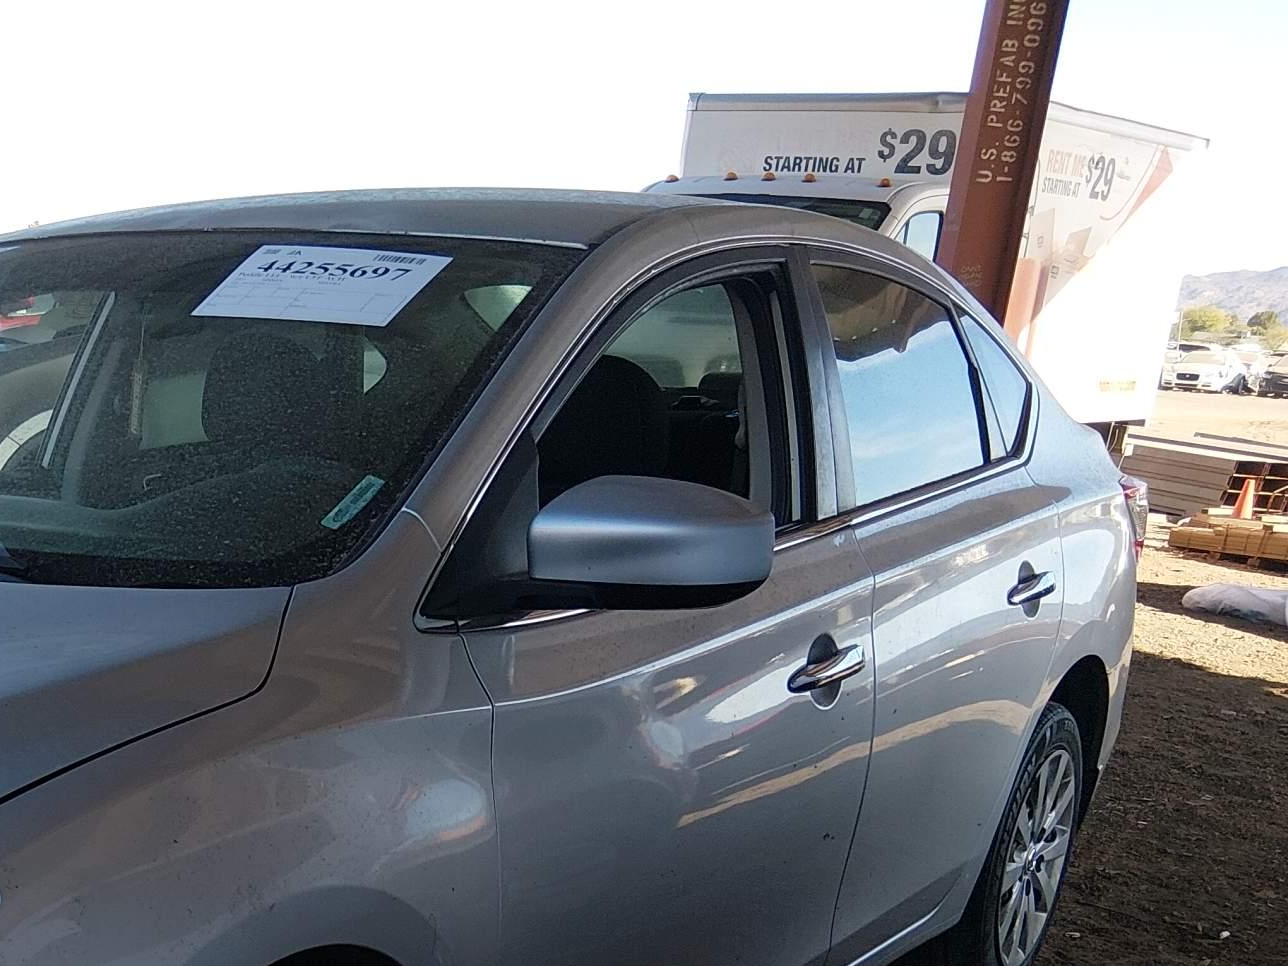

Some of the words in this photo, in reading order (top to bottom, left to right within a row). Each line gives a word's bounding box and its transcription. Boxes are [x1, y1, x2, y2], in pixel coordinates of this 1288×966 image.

[987, 39, 1020, 127] PREFAB
[763, 155, 840, 173] STARTING
[844, 157, 866, 174] AT
[877, 127, 957, 176] $29
[976, 141, 1000, 183] U.S.
[1042, 176, 1072, 197] STARTING
[1072, 182, 1082, 198] AT
[1085, 154, 1116, 202] $29
[257, 259, 412, 281] 44255697
